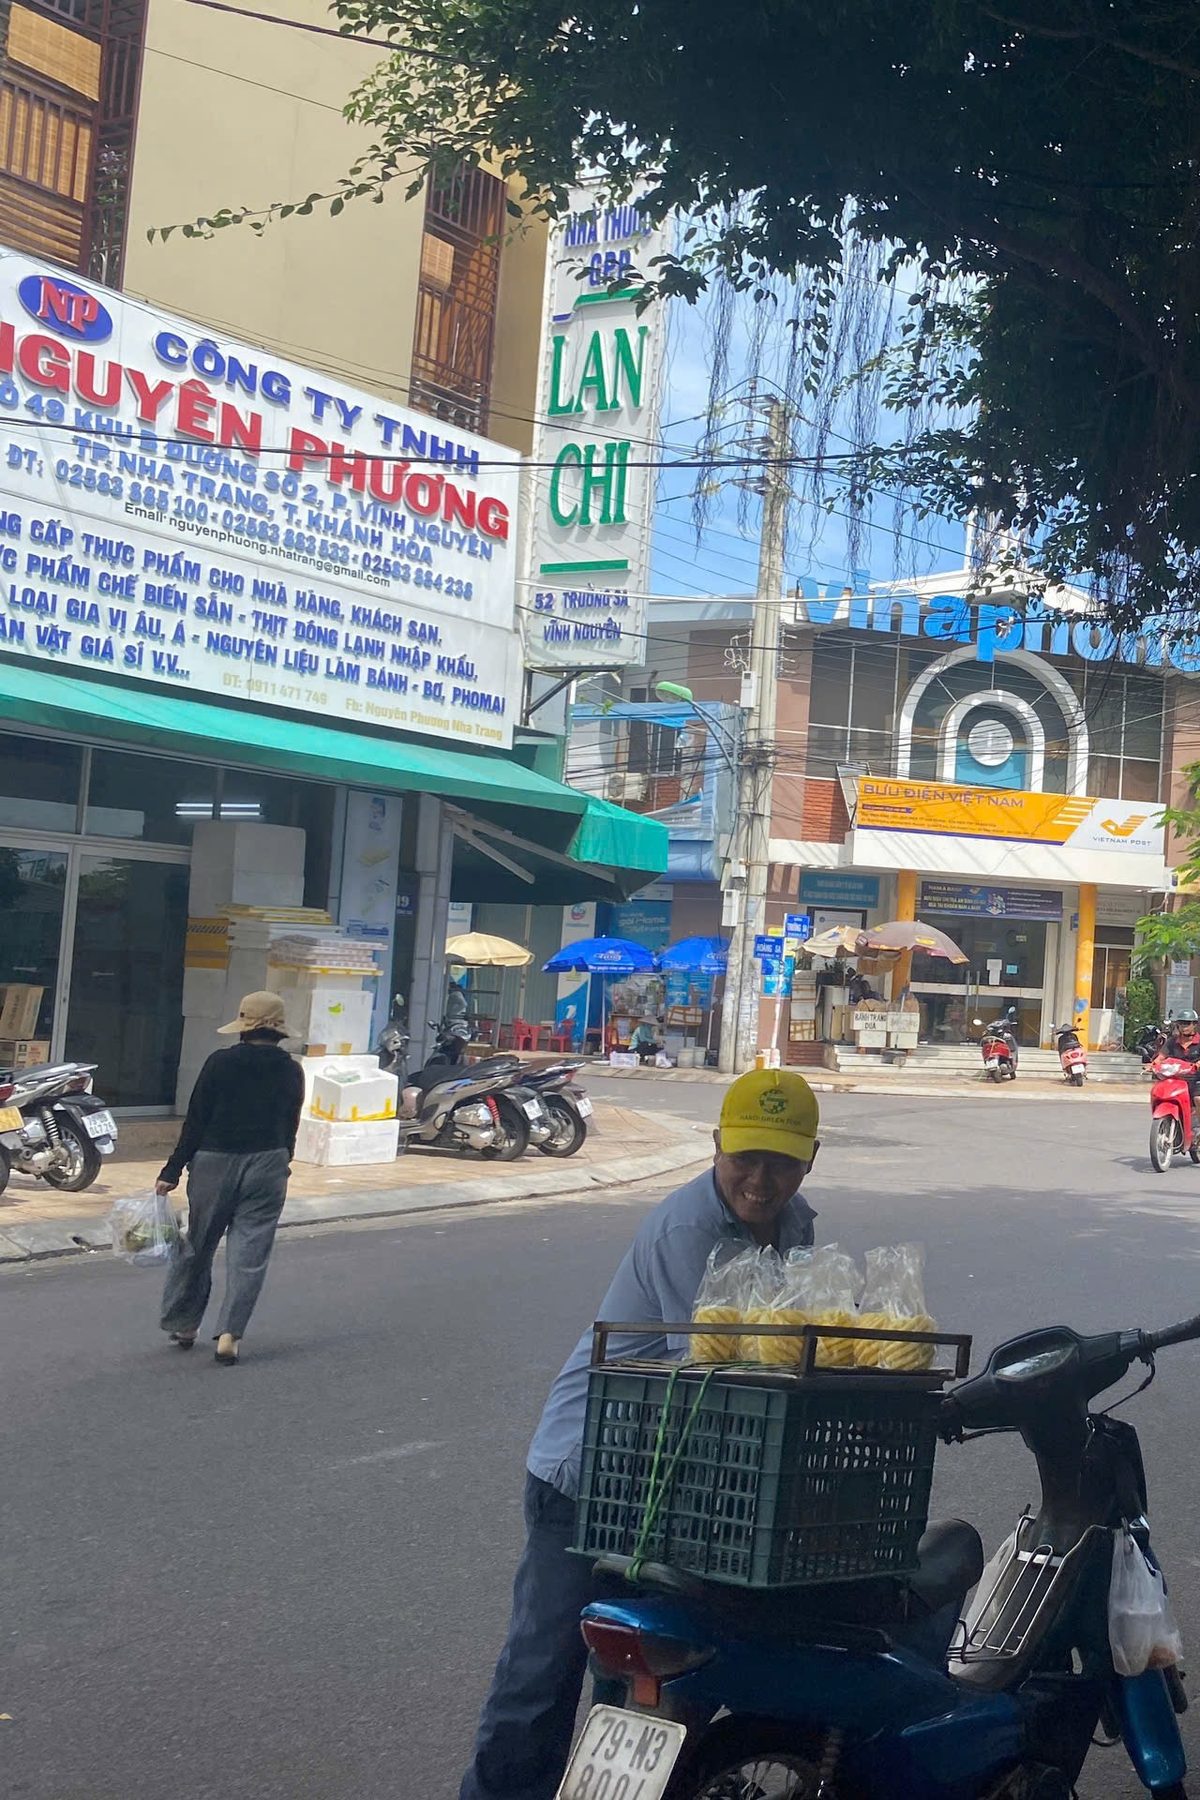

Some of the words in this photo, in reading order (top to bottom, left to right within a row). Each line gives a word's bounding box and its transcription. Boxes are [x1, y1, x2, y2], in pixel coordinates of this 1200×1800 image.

[38, 277, 98, 332] NP
[154, 331, 292, 404] CÔNG
[304, 386, 363, 430] TY
[374, 413, 479, 475] TNHH
[547, 325, 649, 417] LAN
[0, 378, 19, 411] Ô
[25, 393, 65, 421] 49
[74, 408, 133, 444] KHU
[358, 499, 407, 531] VĨNH
[412, 518, 493, 561] NGUYÊN
[118, 451, 176, 486] NHA
[181, 470, 275, 520] TRANG,
[306, 509, 383, 548] KHÁNH
[287, 427, 509, 541] PHƯƠNG
[549, 441, 631, 527] CHI
[82, 532, 135, 568] THỰC
[209, 567, 244, 596] CHO
[252, 578, 288, 606] NHÀ
[351, 604, 402, 634] KHÁCH
[169, 516, 391, 588] nguyenphuong.nhatrang@gmail.com
[174, 495, 208, 523] 100
[361, 551, 411, 582] 02583
[444, 575, 473, 600] 238
[144, 582, 188, 614] BIẾN
[251, 609, 288, 640] THỊT
[343, 632, 385, 660] LẠNH
[534, 592, 554, 610] 52
[613, 590, 629, 607] SA
[543, 619, 571, 641] VĨNH
[573, 617, 621, 640] NGUYÊN
[9, 584, 57, 619] LOẠI
[66, 598, 100, 627] GIA
[109, 607, 127, 634] VỊ
[172, 620, 186, 645] Á
[205, 630, 278, 665] NGUYÊN
[283, 648, 319, 676] LIỆU
[324, 656, 360, 684] LÀM
[366, 666, 408, 695] BÁNH
[451, 686, 505, 716] PHOMAI
[80, 635, 114, 661] GIÁ
[452, 719, 472, 733] Nha
[475, 724, 503, 741] Trang
[904, 787, 945, 801] ĐIỆN
[949, 790, 985, 805] VIỆT
[988, 795, 1024, 807] NAM
[1093, 836, 1127, 844] VIETNAM
[591, 1716, 668, 1772] 79-N3
